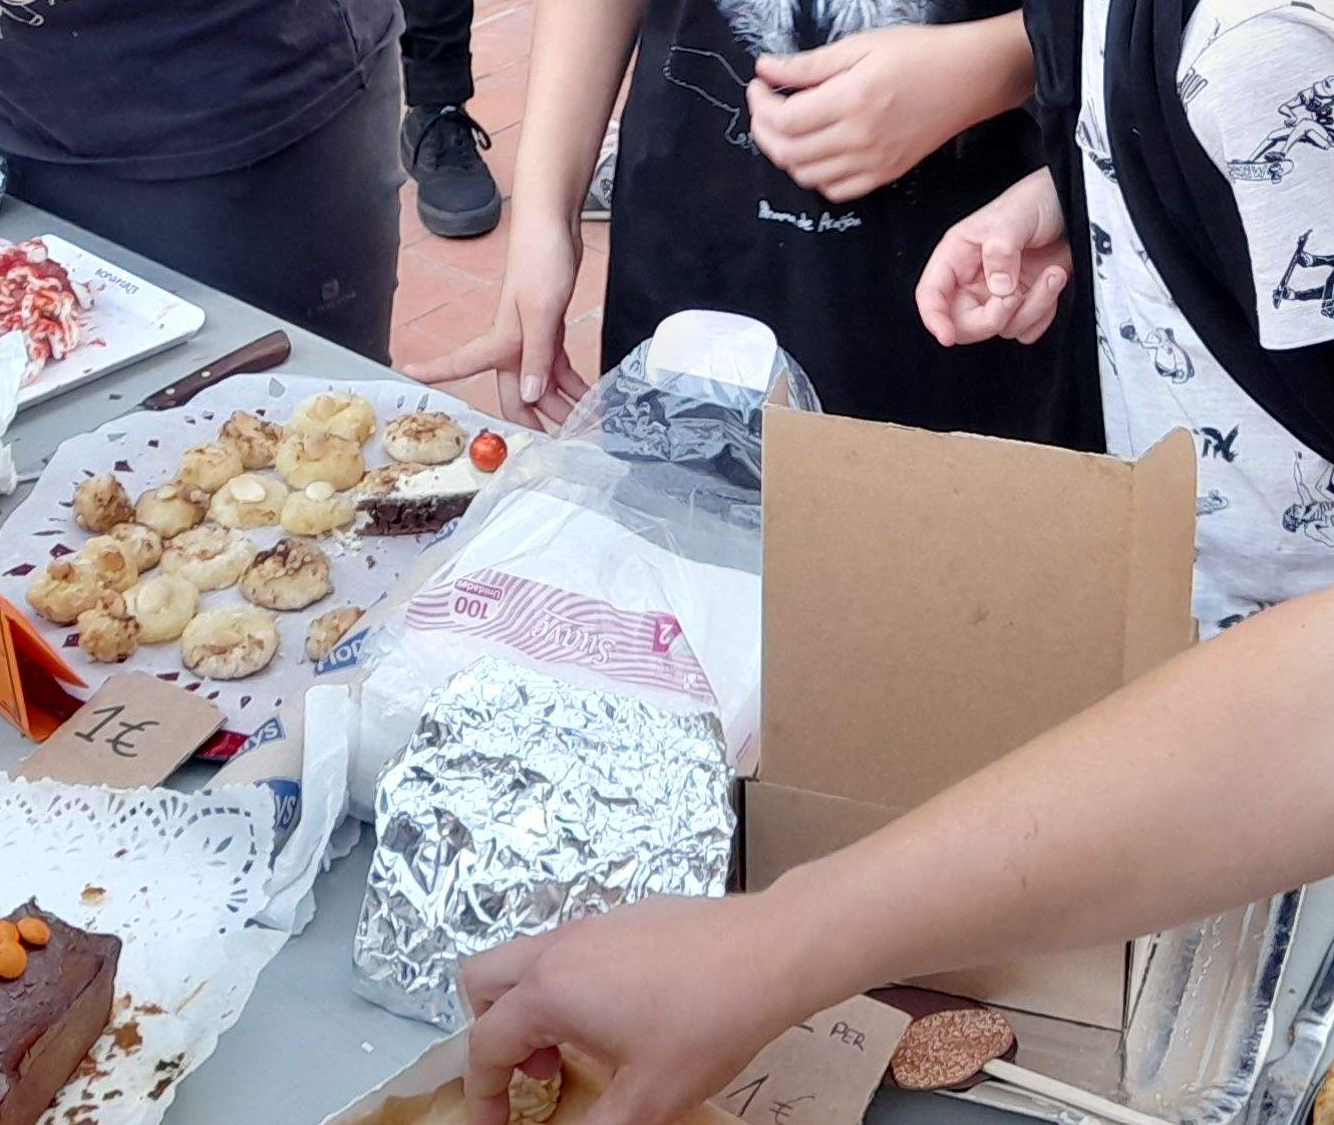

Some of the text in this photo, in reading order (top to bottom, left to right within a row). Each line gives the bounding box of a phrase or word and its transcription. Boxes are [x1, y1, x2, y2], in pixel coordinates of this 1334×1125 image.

[455, 578, 503, 600] Unidades
[453, 595, 489, 620] 100
[531, 617, 616, 665] Suave
[73, 704, 160, 758] 1€
[829, 1021, 866, 1052] PER
